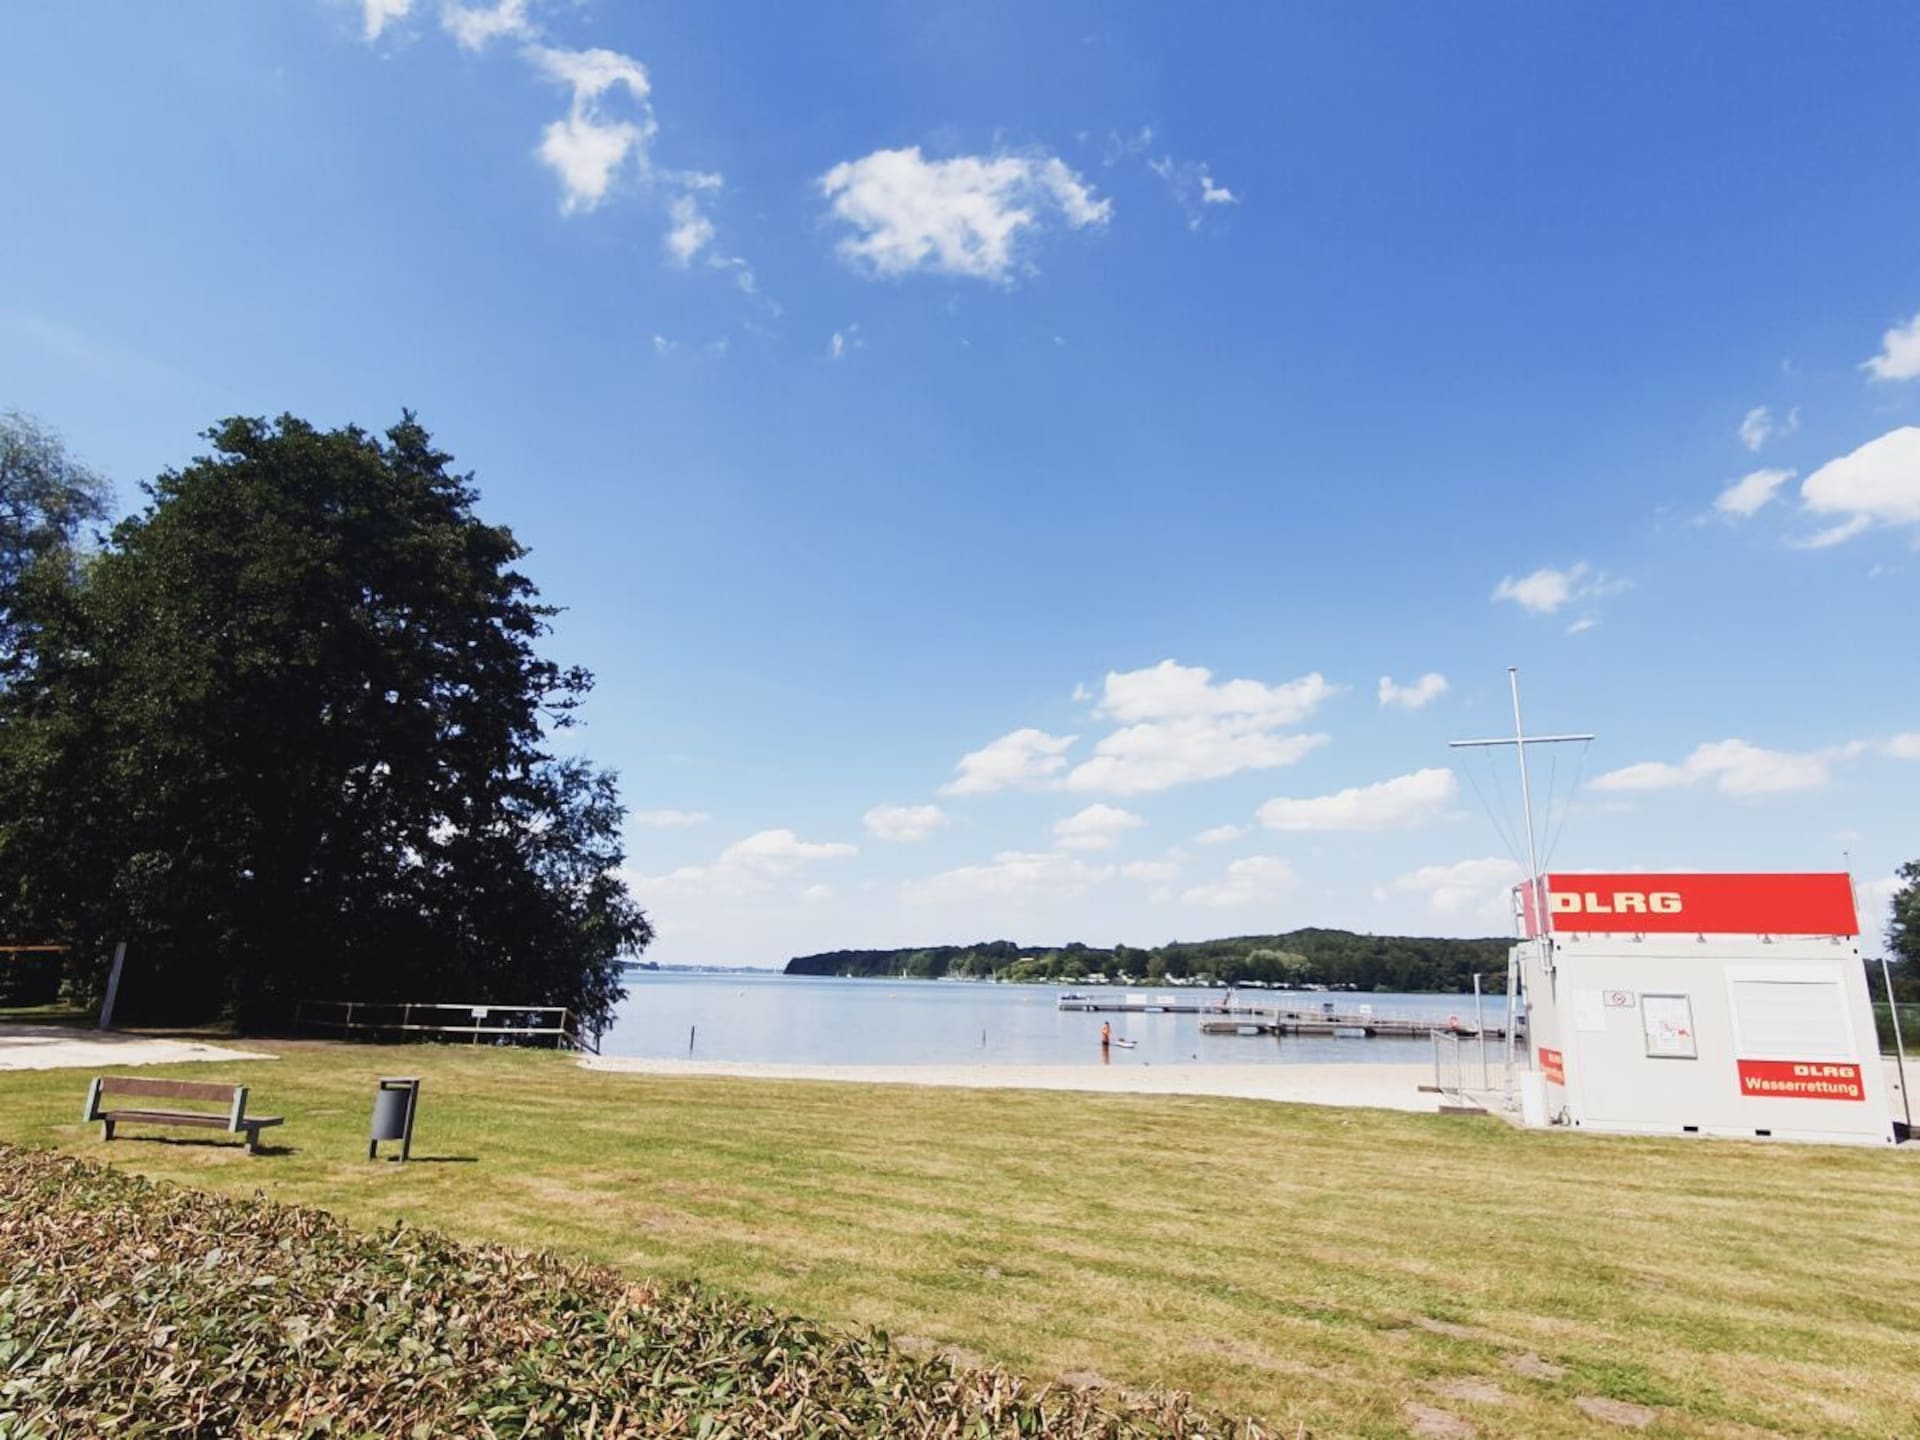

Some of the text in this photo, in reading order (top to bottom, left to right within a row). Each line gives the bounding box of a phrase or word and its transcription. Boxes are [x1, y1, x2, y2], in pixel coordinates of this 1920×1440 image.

[1550, 892, 1682, 913] DLRG
[1793, 1064, 1855, 1078] DLRG
[1745, 1076, 1859, 1097] Wasserrettung
